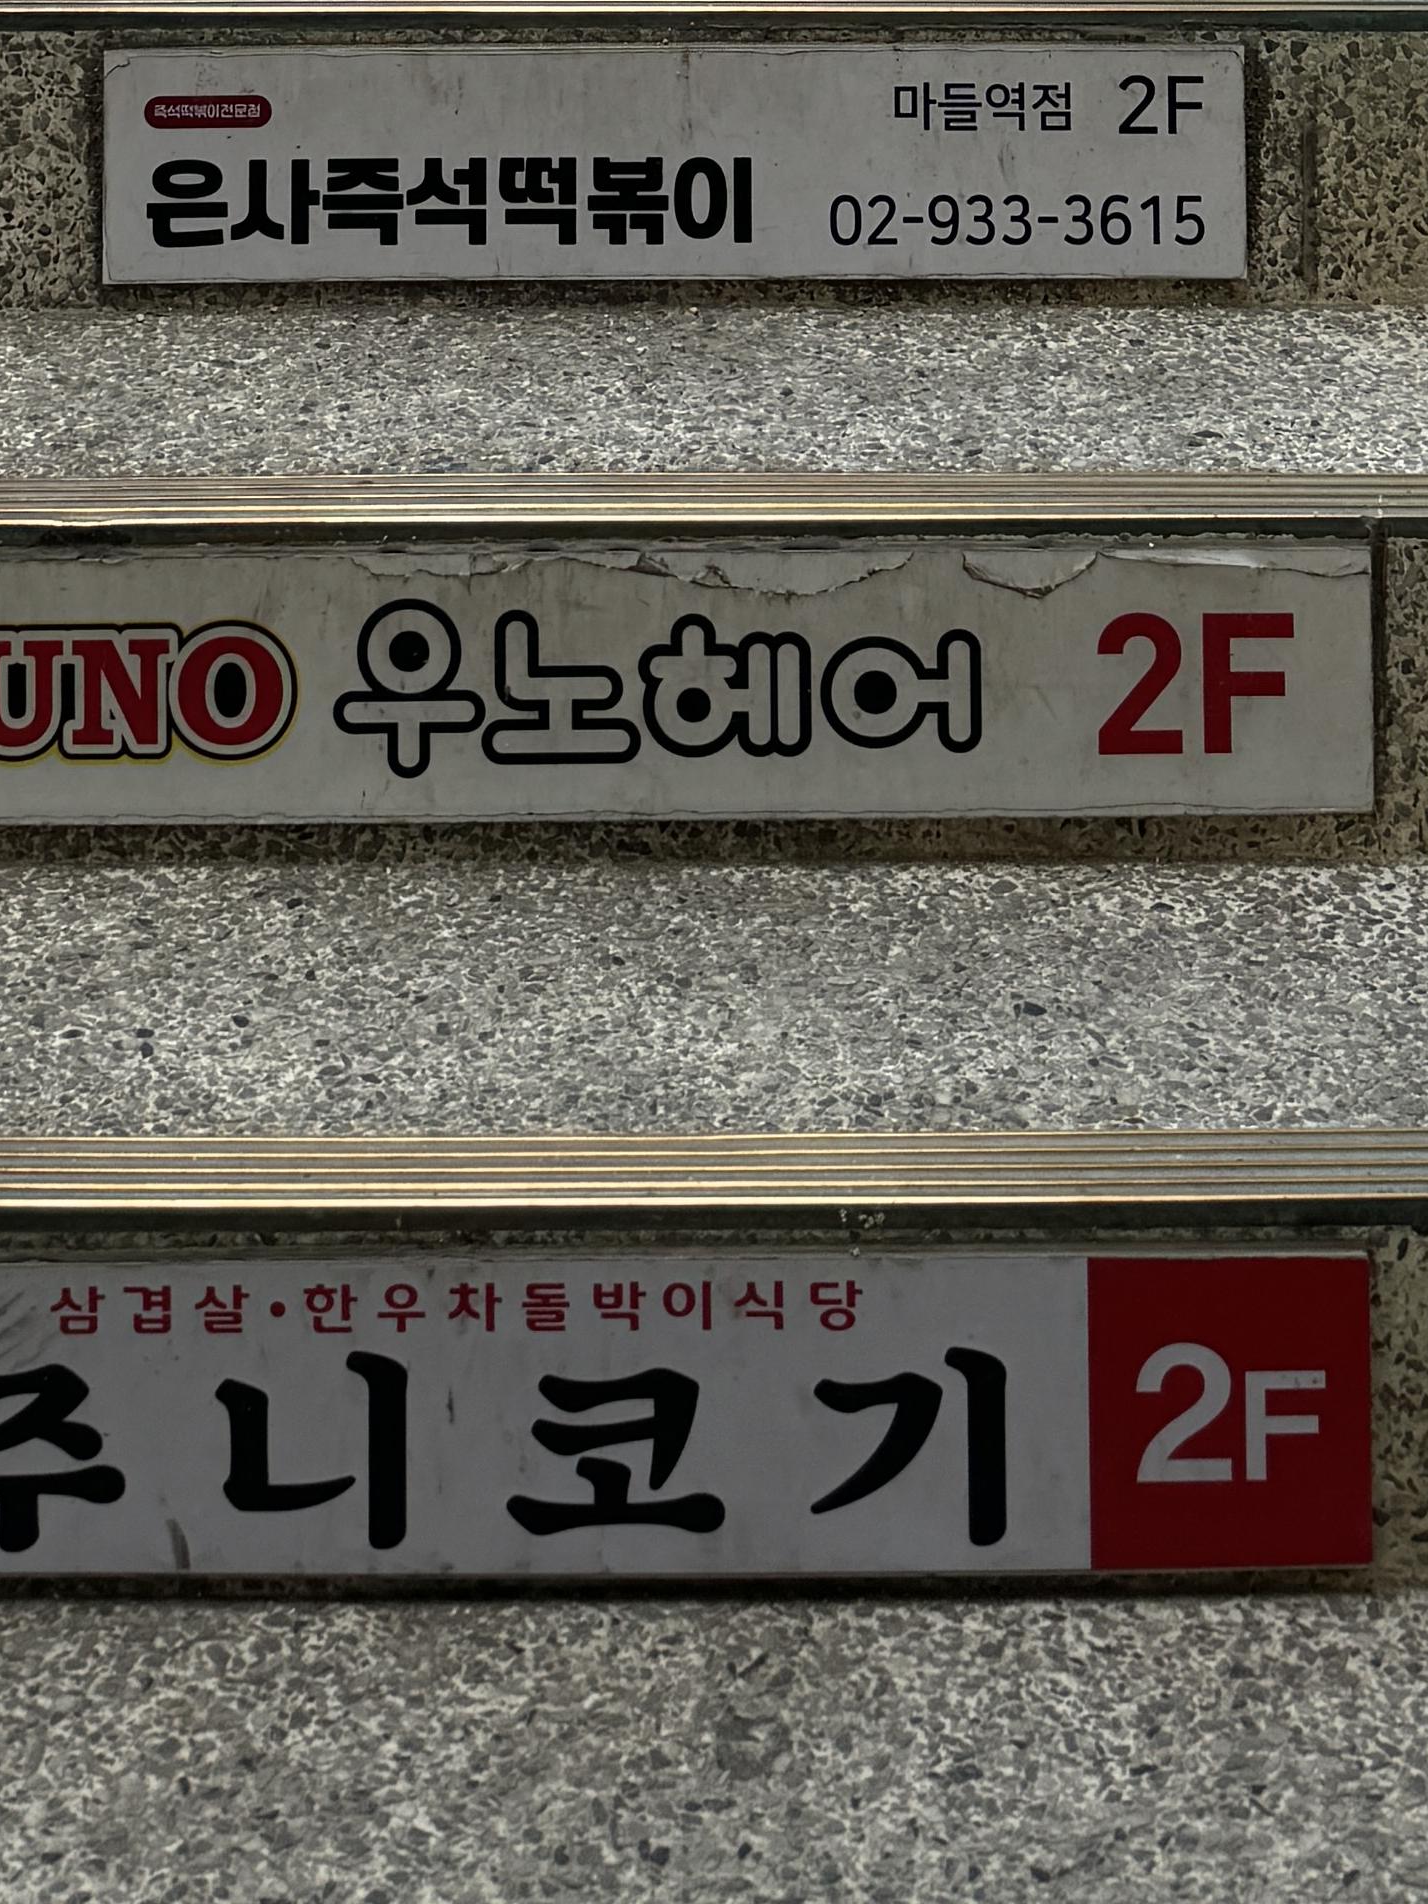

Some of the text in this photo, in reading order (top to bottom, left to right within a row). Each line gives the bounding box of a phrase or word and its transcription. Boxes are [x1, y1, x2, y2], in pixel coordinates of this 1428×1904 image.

[894, 75, 1206, 136] 마들역점 2F
[145, 155, 1207, 248] 은사즉석떡볶이 02-933-3615
[334, 597, 983, 779] 우노헤어
[1095, 612, 1295, 756] 2F
[1134, 1341, 1328, 1485] 2F
